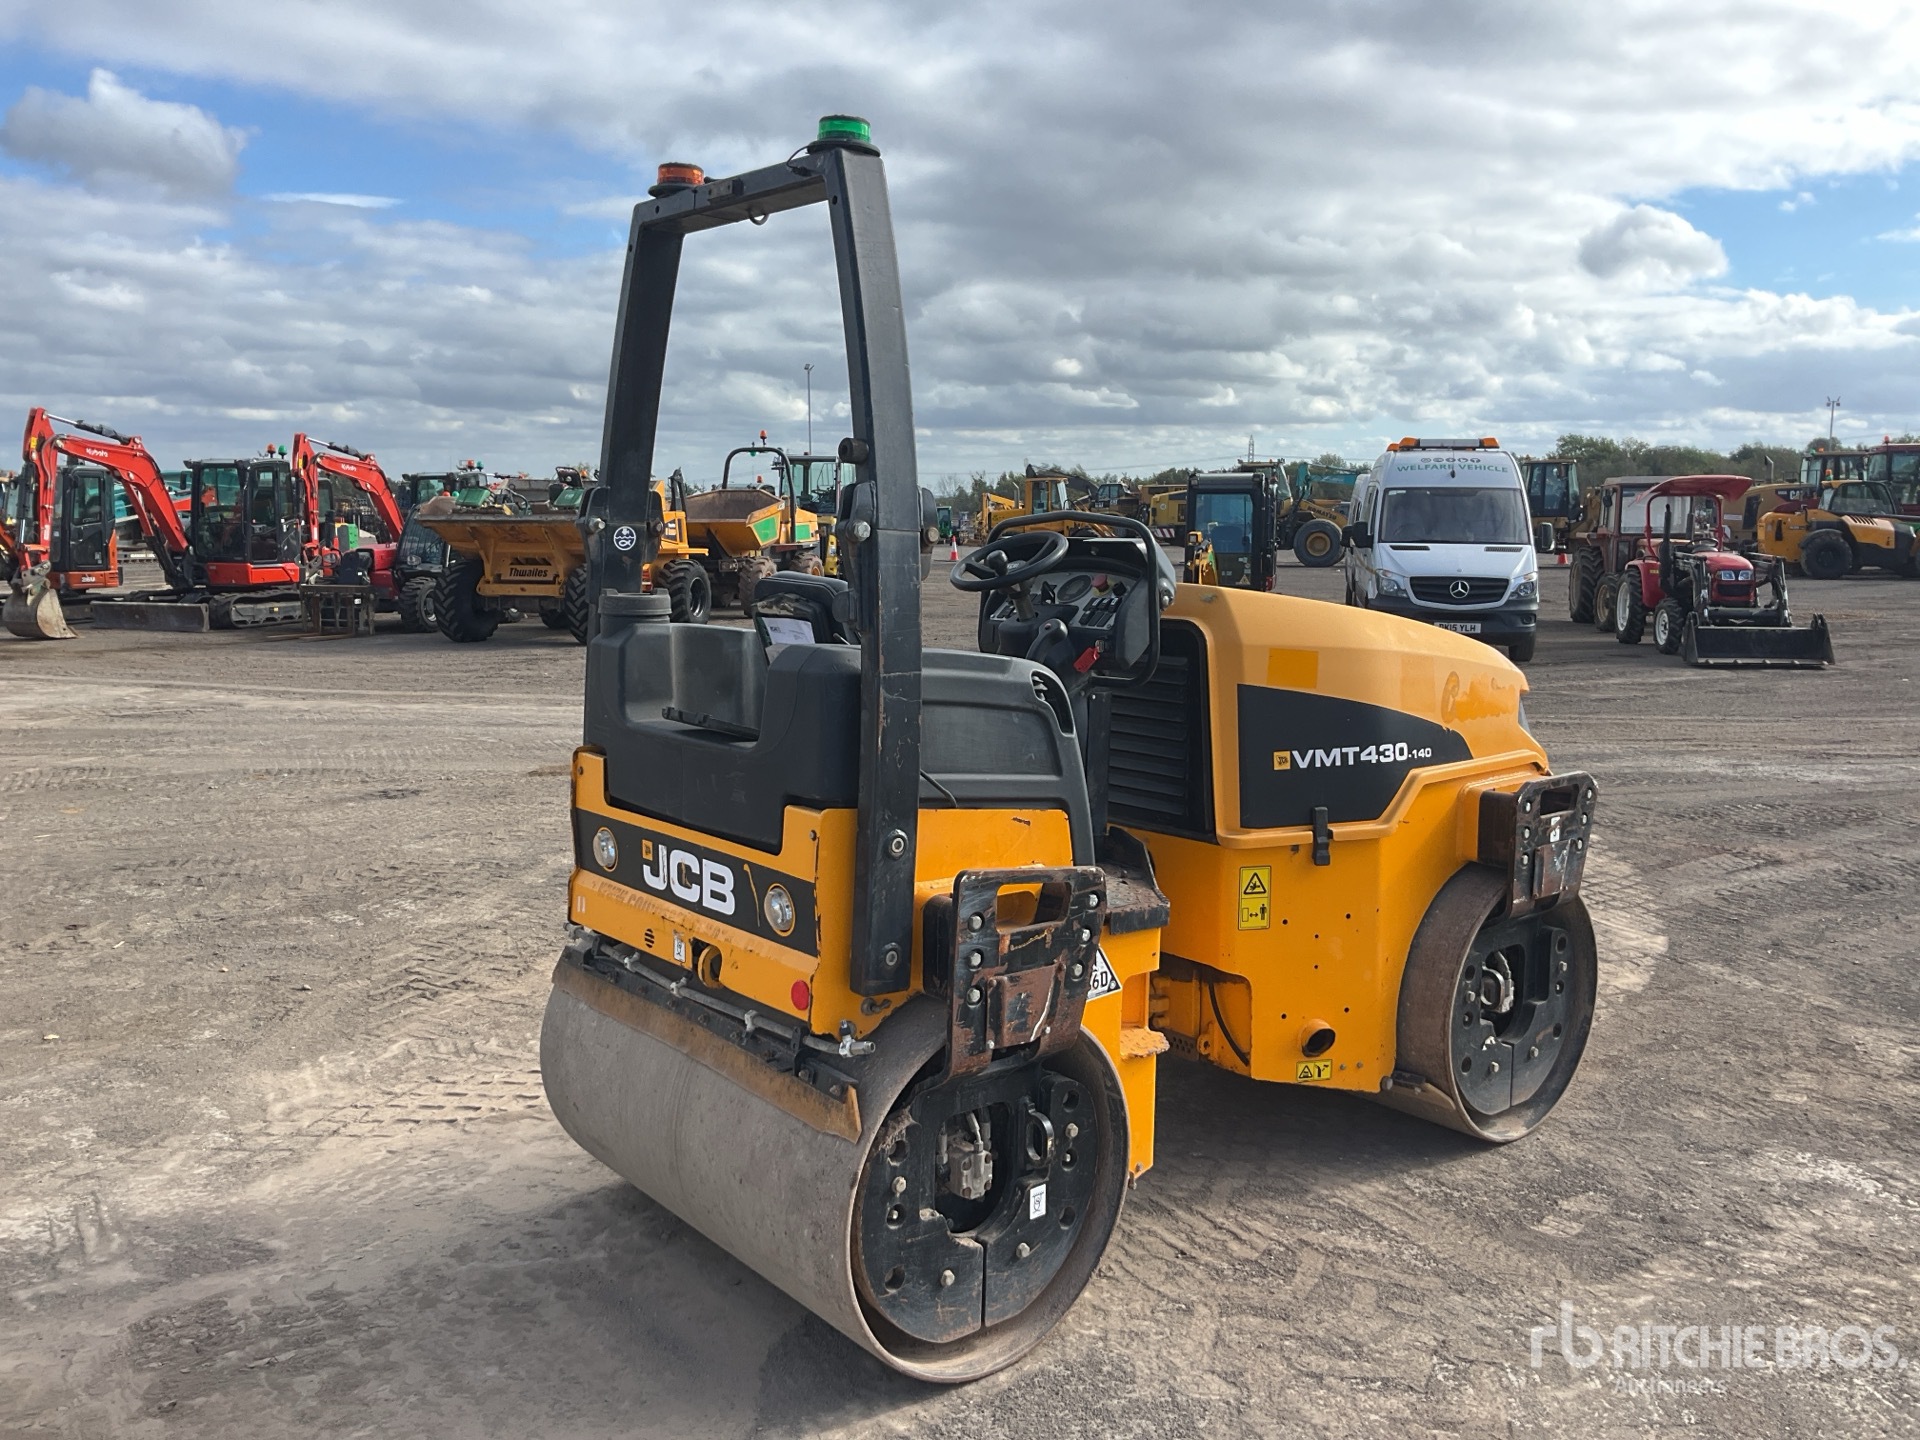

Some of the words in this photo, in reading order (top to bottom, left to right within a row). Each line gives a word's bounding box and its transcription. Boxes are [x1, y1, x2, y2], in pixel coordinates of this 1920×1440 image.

[86, 447, 108, 457] Kubota
[1397, 463, 1453, 472] WELFARE
[1458, 463, 1508, 473] VEHICLE
[1307, 505, 1337, 520] KOMATSU
[509, 567, 549, 577] Thwaites
[1459, 624, 1476, 632] YLH
[643, 844, 735, 916] JCB
